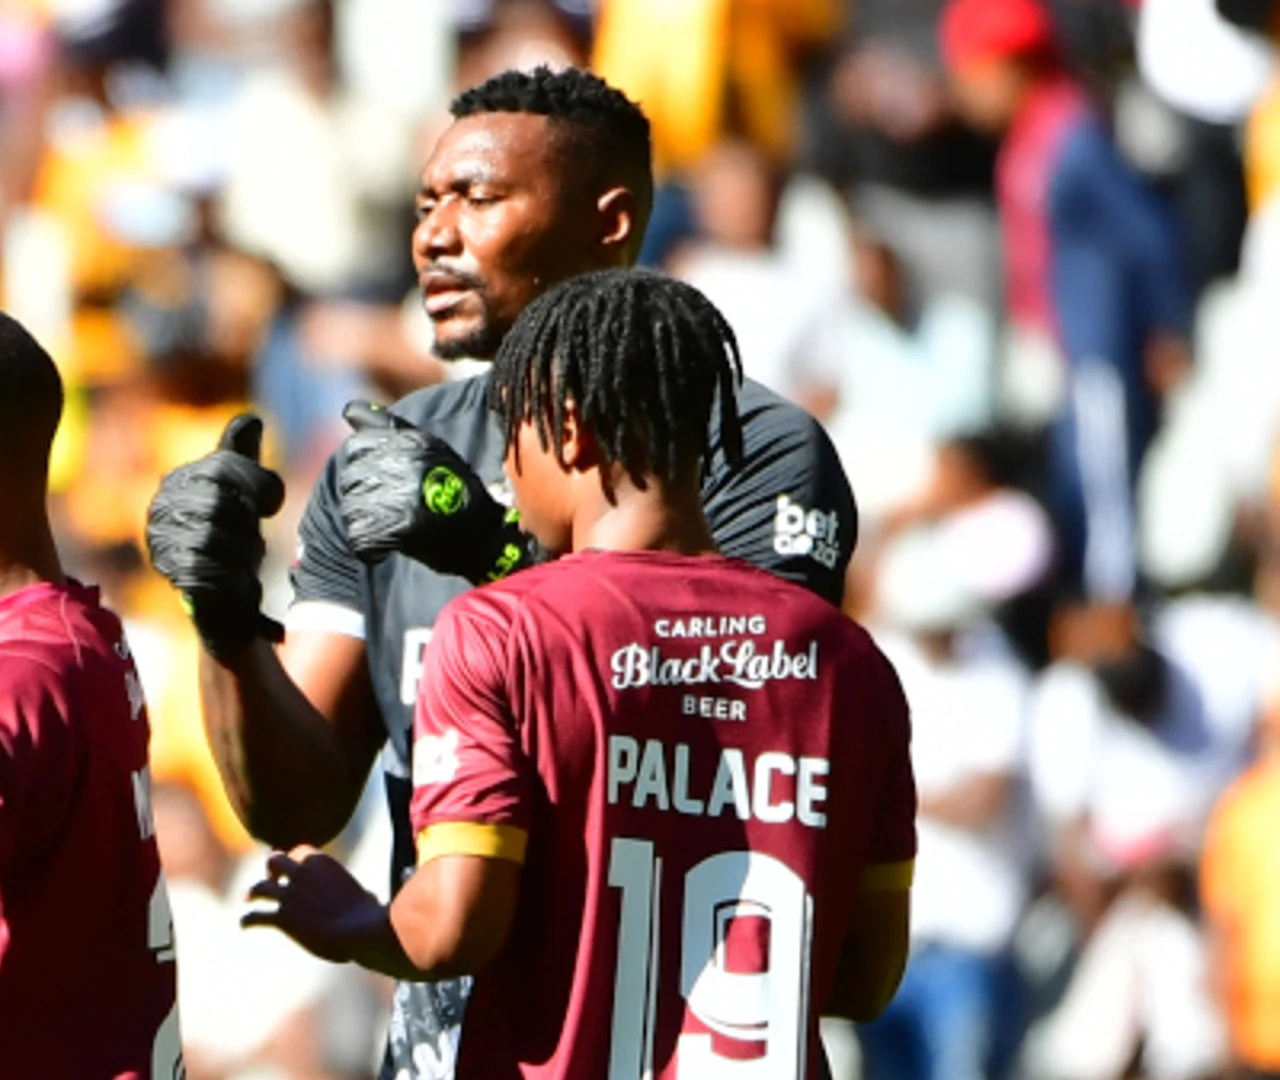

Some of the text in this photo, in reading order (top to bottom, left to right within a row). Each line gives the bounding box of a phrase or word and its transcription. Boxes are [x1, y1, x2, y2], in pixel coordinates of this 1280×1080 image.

[653, 614, 767, 638] CARLING
[610, 638, 818, 690] Black Label
[682, 695, 747, 721] BEER
[607, 735, 831, 829] PALACE
